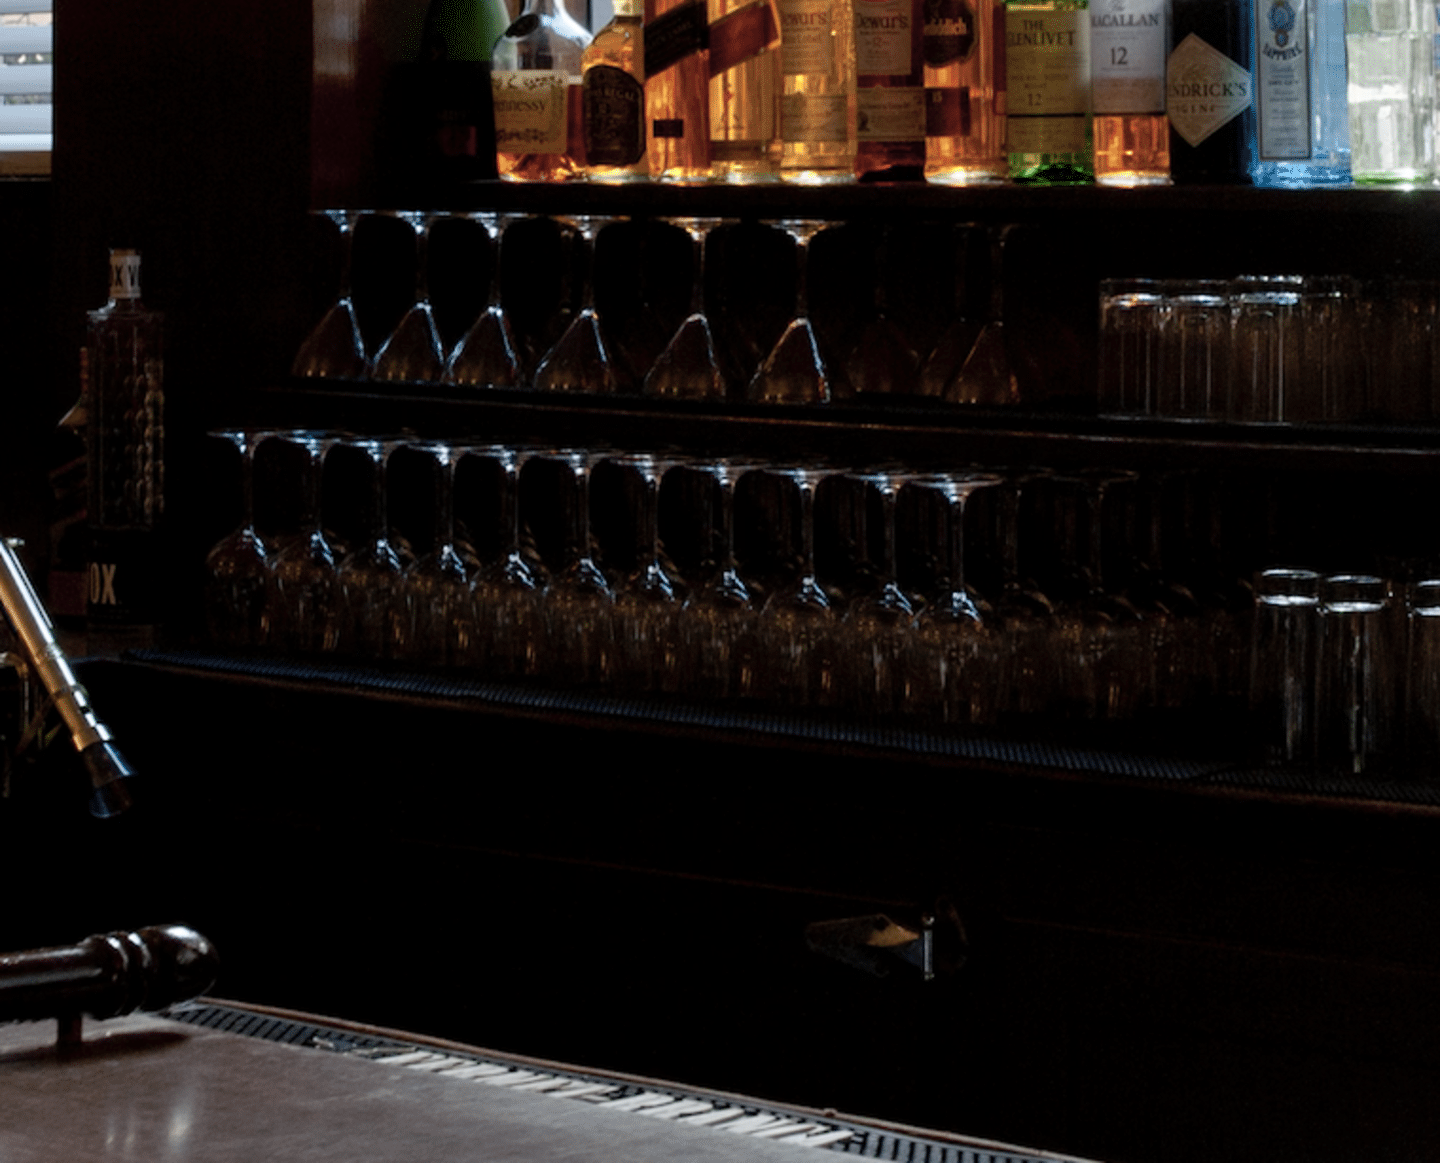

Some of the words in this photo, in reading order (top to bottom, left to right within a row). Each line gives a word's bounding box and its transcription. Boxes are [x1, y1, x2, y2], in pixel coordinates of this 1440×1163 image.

[1023, 19, 1043, 30] THE
[1109, 46, 1128, 66] 12
[1169, 82, 1247, 98] NDRICK'S
[493, 98, 546, 114] ennessy
[1028, 93, 1042, 107] 12
